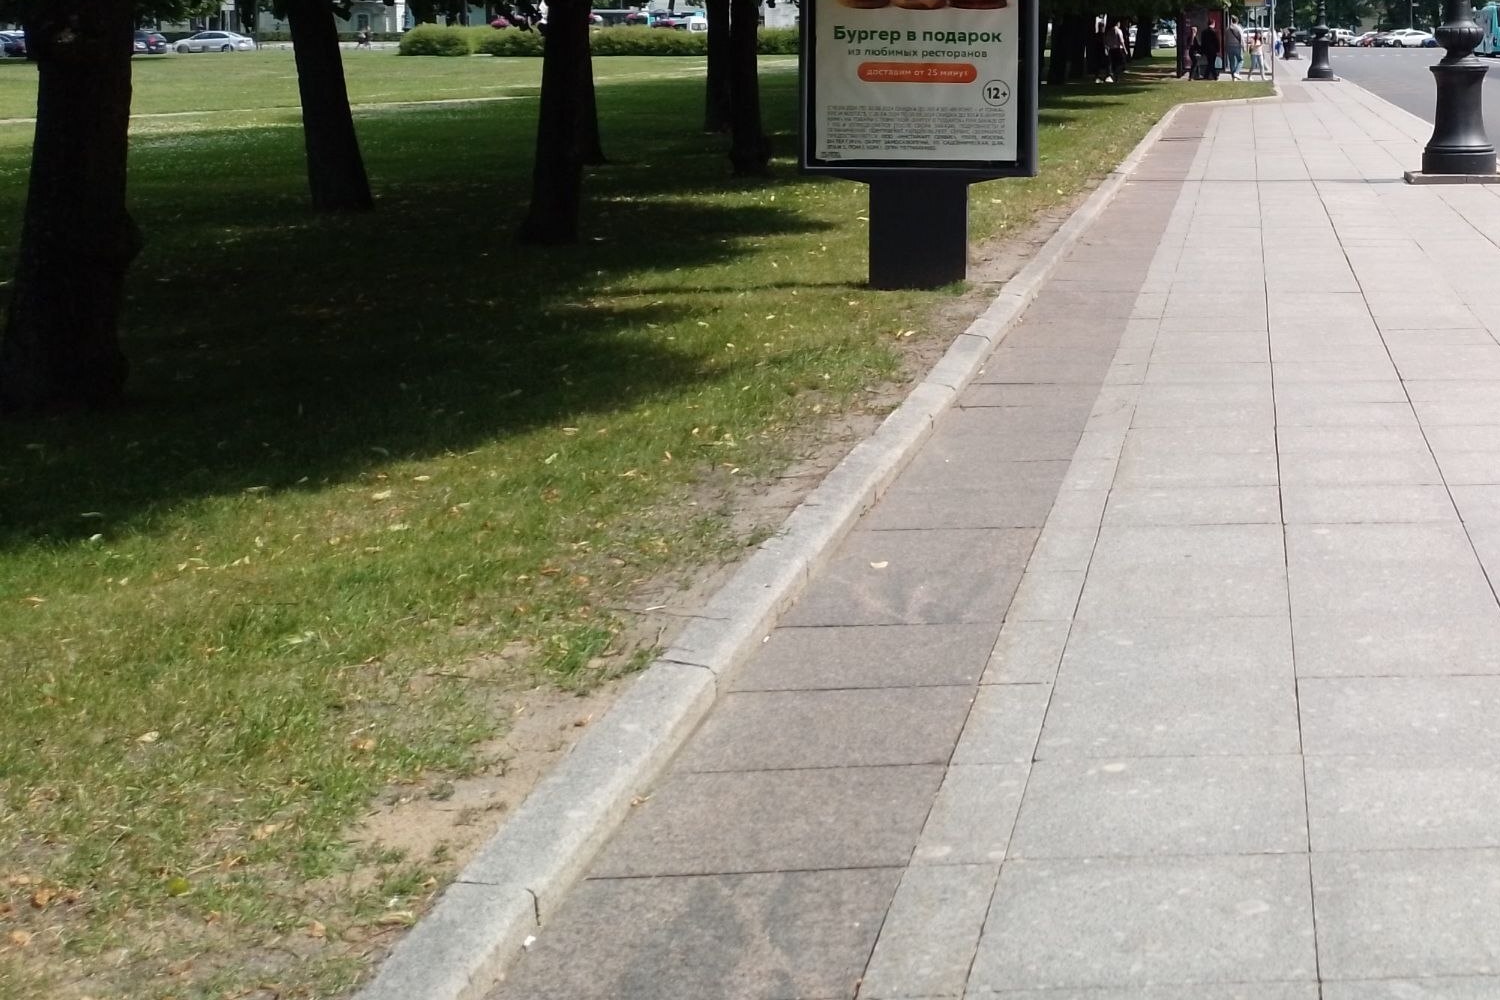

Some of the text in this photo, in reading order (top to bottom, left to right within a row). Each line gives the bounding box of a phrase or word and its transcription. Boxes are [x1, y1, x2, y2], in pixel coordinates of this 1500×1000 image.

[833, 26, 1002, 45] Бургер в подарок
[864, 47, 918, 57] любимых
[921, 49, 987, 59] ресторанов
[866, 69, 912, 77] доставим
[927, 68, 938, 76] 25
[940, 69, 968, 78] минут
[986, 87, 1008, 100] 12+
